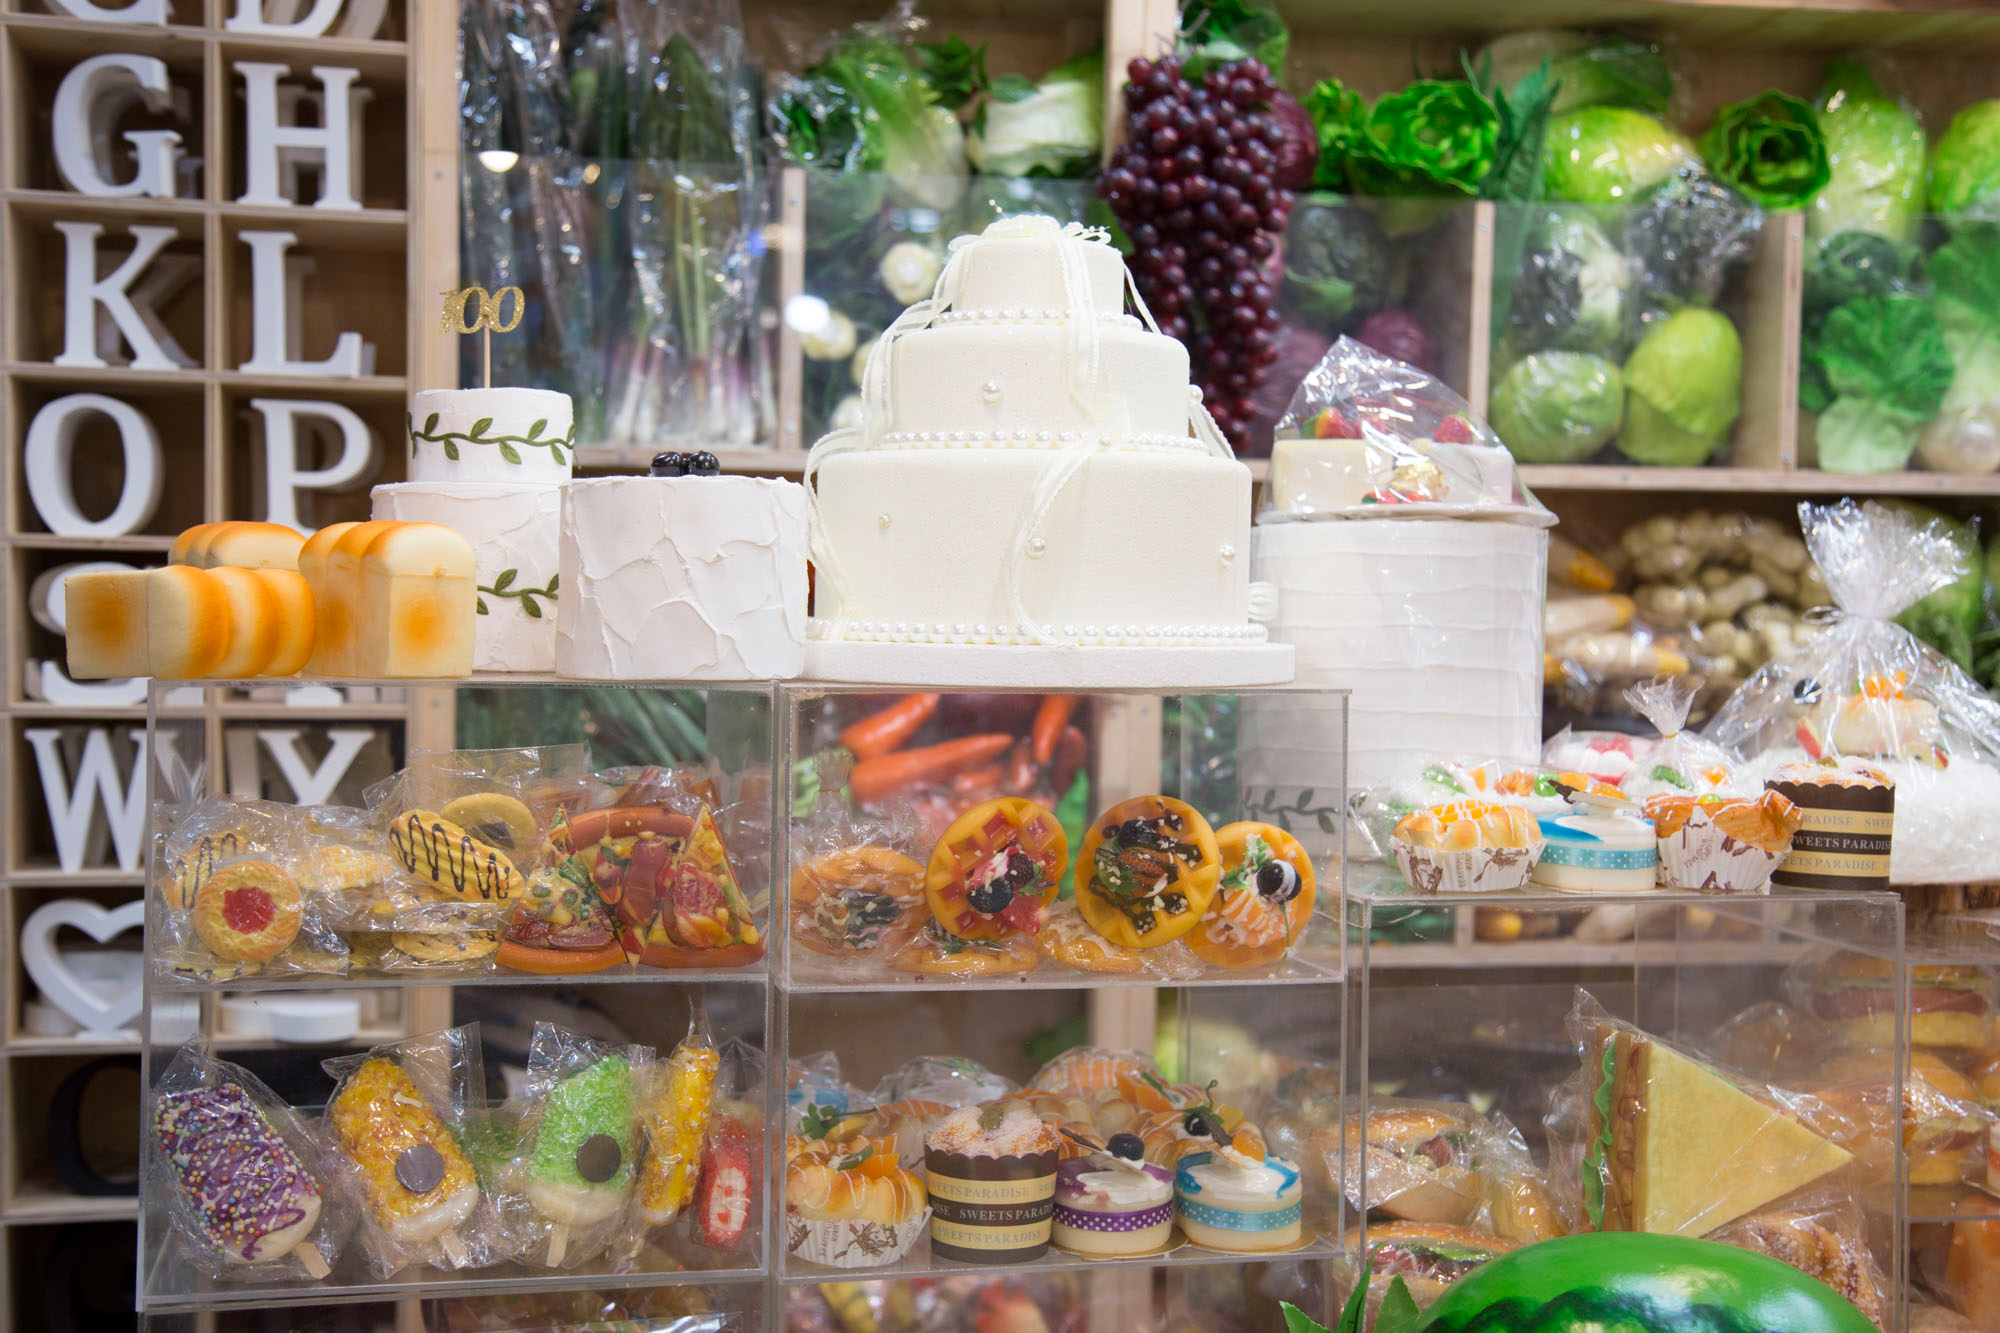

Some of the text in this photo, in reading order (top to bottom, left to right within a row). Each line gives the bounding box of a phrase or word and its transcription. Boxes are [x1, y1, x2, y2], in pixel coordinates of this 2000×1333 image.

[51, 53, 182, 199] G
[233, 61, 363, 211] H
[52, 220, 181, 370] K
[237, 230, 363, 372] L
[439, 286, 525, 334] 100
[24, 393, 160, 538] O
[249, 398, 372, 538] P
[24, 728, 178, 875] W
[256, 729, 376, 806] Y
[959, 1207, 1014, 1222] SWEETS
